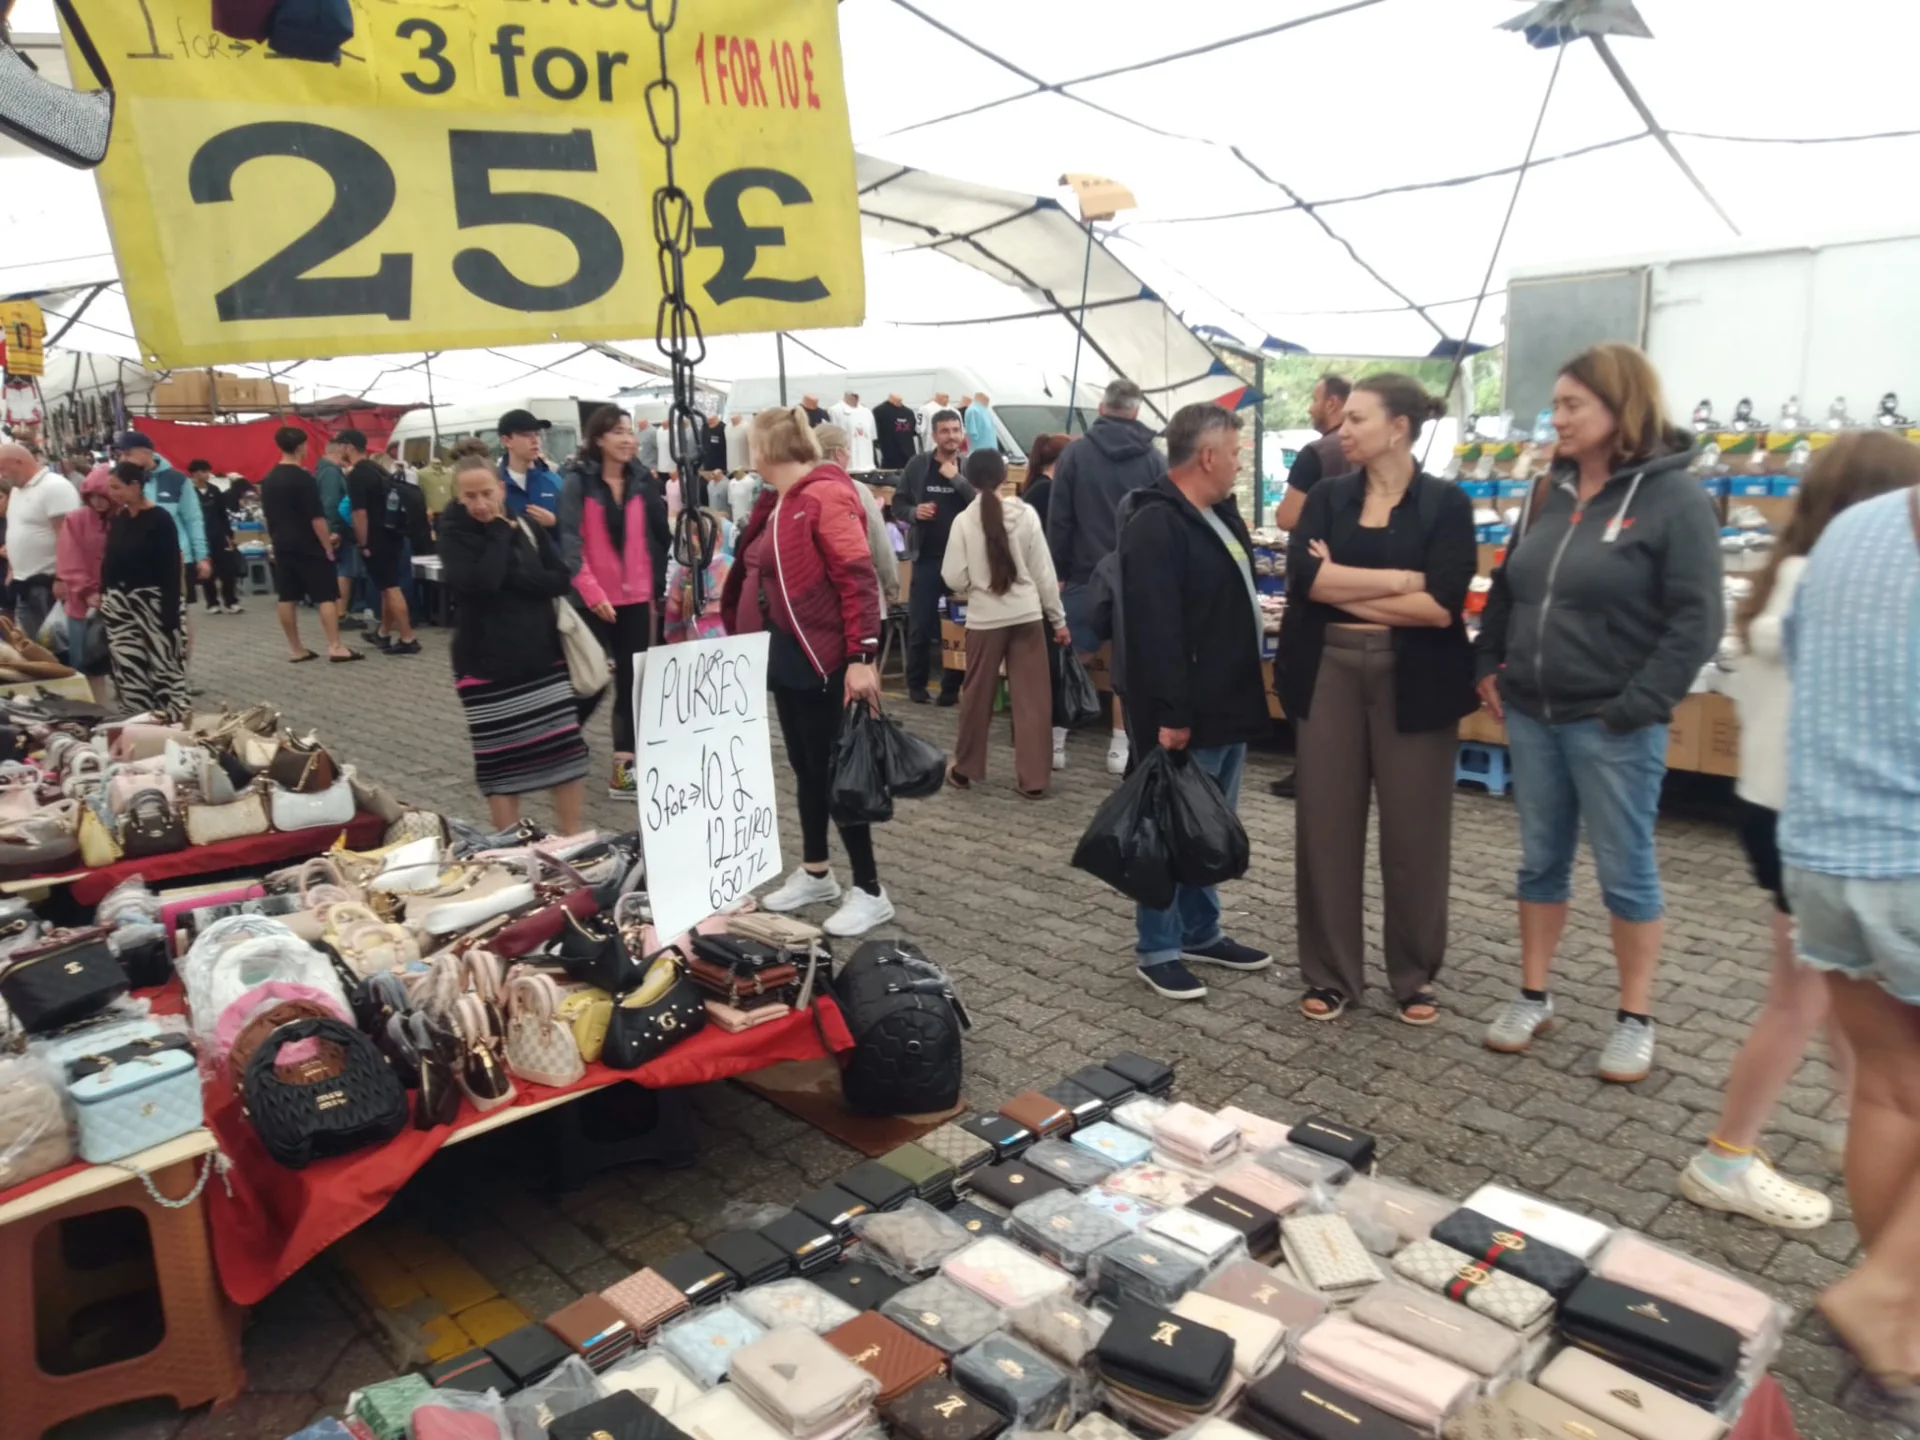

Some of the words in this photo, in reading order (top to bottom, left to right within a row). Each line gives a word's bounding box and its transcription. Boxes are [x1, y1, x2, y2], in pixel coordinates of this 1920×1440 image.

[395, 18, 457, 95] 3
[489, 24, 629, 103] for
[695, 32, 710, 106] 1
[715, 34, 769, 108] FOR
[769, 39, 799, 110] 10
[802, 40, 821, 111] £
[188, 120, 624, 323] 25
[693, 167, 831, 306] £
[659, 649, 751, 728] PURSES
[646, 767, 662, 831] 3
[701, 744, 724, 811] 10
[730, 735, 753, 812] £
[706, 817, 732, 869] 12
[732, 806, 772, 859] EURO
[709, 865, 743, 910] 650
[746, 847, 768, 884] TL
